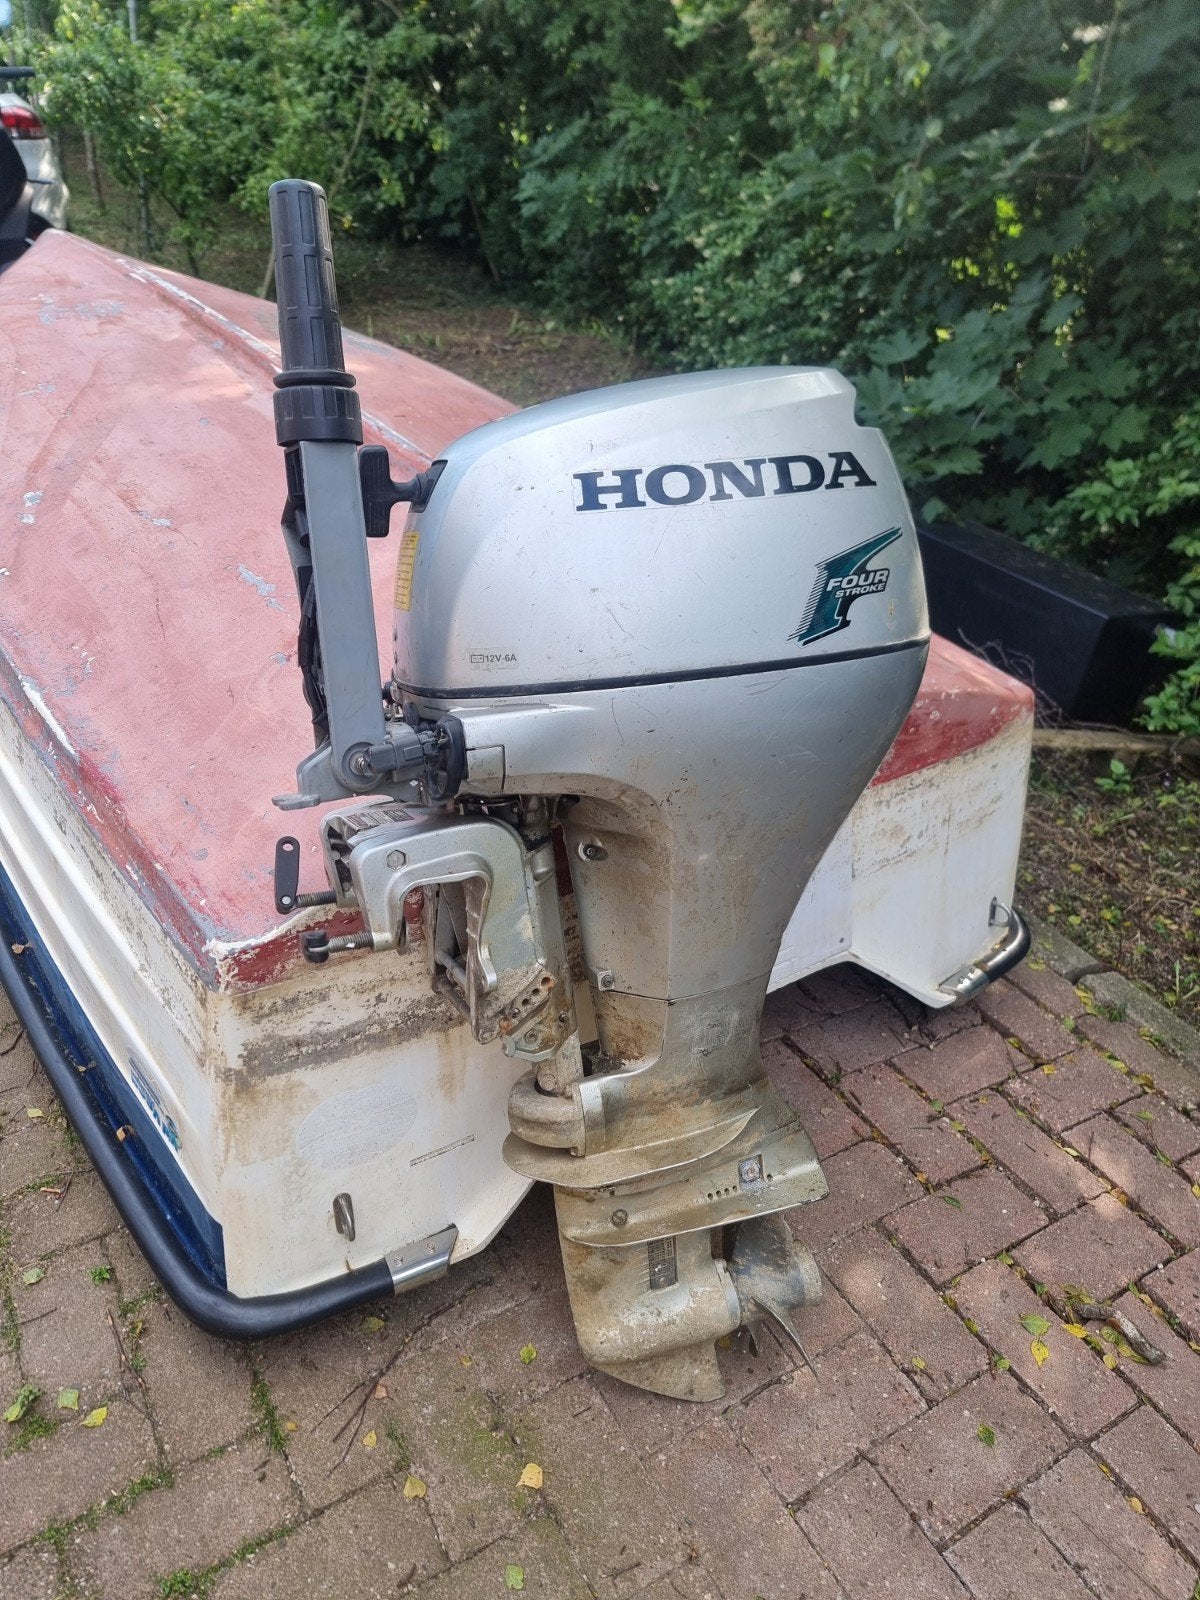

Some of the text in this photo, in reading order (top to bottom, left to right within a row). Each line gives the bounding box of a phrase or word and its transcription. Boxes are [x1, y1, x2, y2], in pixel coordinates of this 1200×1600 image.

[573, 451, 877, 512] HONDA
[826, 570, 889, 592] FOUR
[835, 582, 885, 598] STROKE
[485, 654, 517, 662] 12V-6A
